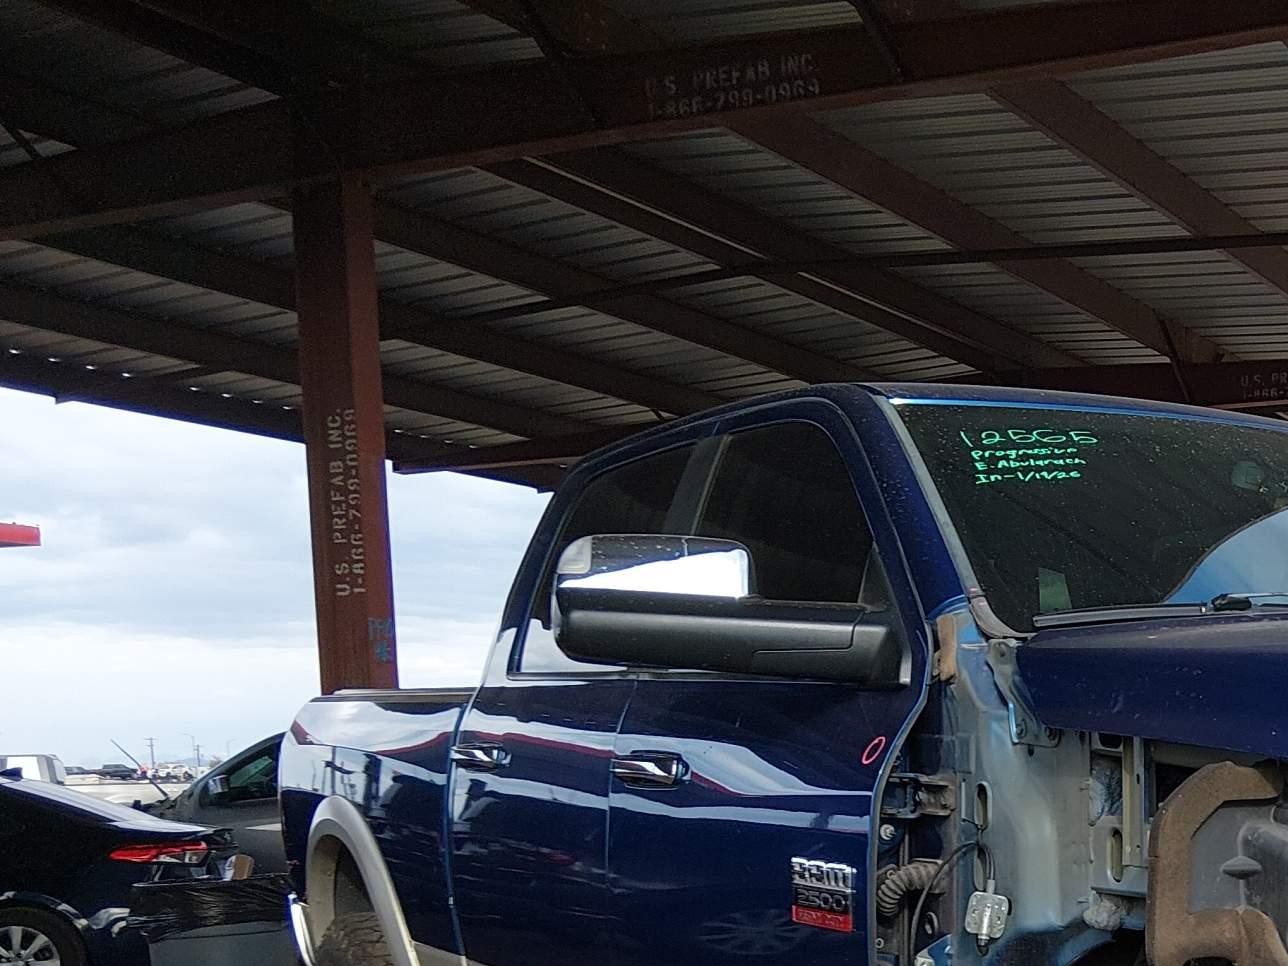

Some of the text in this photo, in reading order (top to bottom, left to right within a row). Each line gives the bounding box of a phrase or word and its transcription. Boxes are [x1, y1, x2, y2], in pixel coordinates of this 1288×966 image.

[327, 408, 343, 449] INC.
[960, 429, 1098, 447] 12565
[329, 460, 348, 544] PREFAB
[797, 888, 847, 912] 2500
